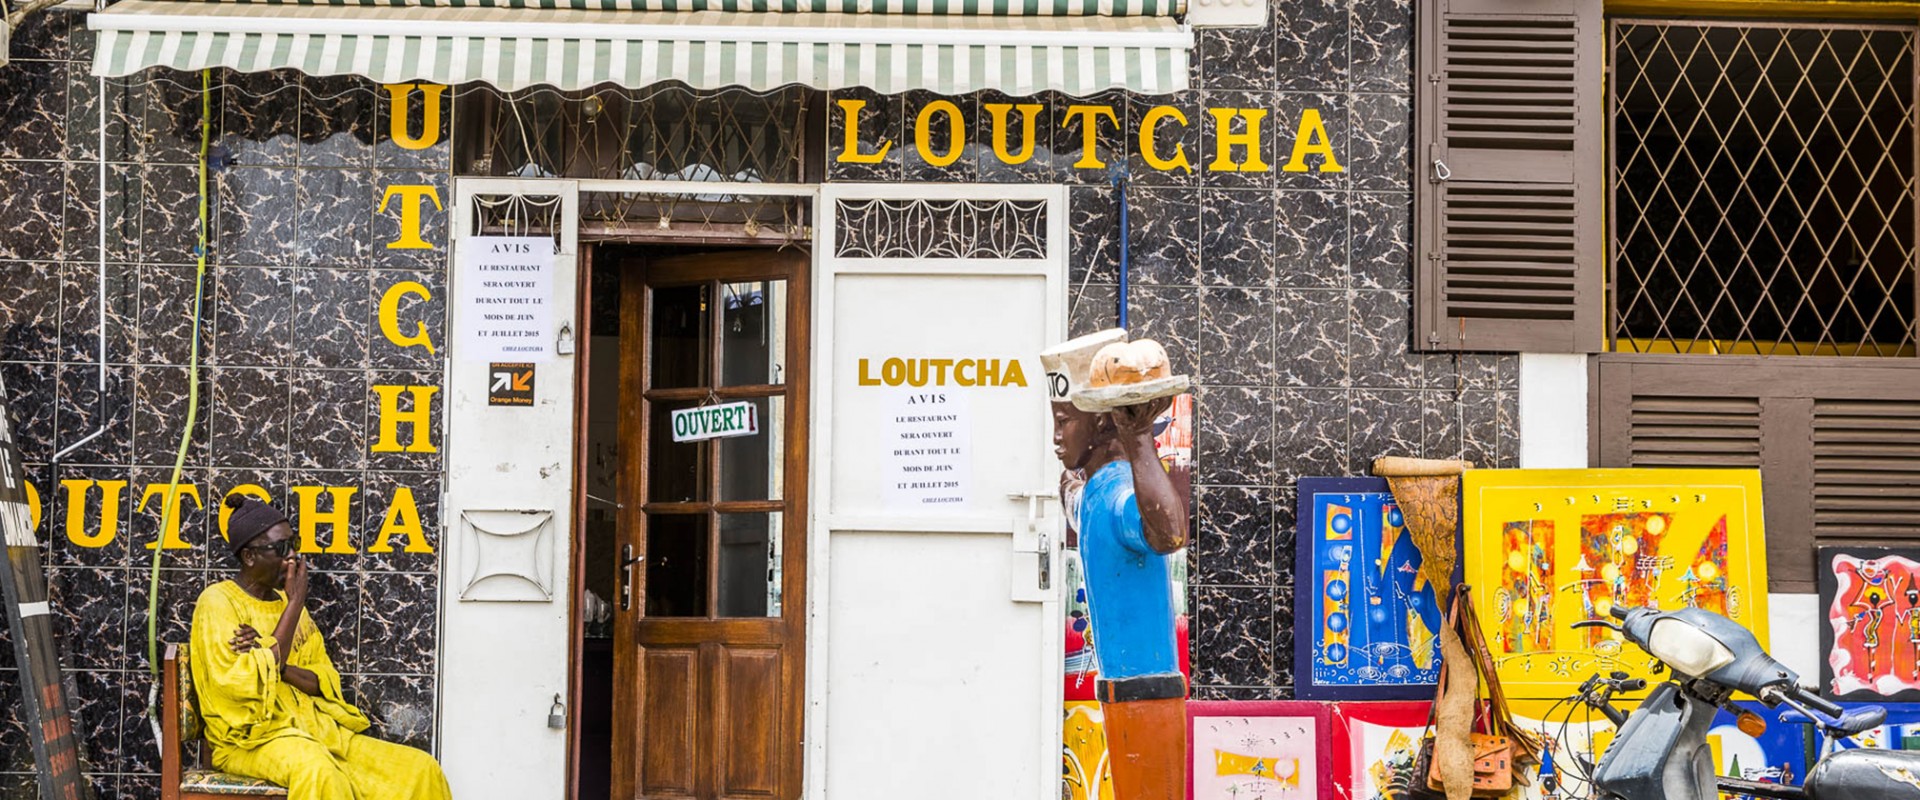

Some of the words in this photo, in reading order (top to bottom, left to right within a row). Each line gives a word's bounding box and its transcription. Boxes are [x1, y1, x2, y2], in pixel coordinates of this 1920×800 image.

[837, 99, 1343, 174] LOUTCHA
[491, 243, 531, 254] AVIS
[479, 264, 489, 272] LE
[490, 264, 541, 272] RESTAURANT
[483, 280, 503, 289] SERA
[504, 280, 536, 289] OUVERT
[475, 297, 507, 305] DURANT
[508, 297, 529, 305] TOUT
[532, 297, 543, 305] LE
[483, 313, 503, 321] MOIS
[505, 313, 515, 321] DE
[517, 313, 535, 321] JUIN
[478, 330, 488, 338] ET
[491, 330, 523, 338] JUILLET
[524, 330, 540, 338] 2015
[858, 357, 1028, 387] LOUTCHA
[490, 396, 511, 404] Orange
[512, 396, 533, 404] Money
[907, 394, 946, 404] AVIS
[675, 405, 746, 437] OUVERT
[907, 415, 958, 423] RESTAURANT
[900, 432, 920, 440] SERA
[893, 448, 925, 456] DURANT
[927, 448, 947, 456] TOUT
[902, 465, 922, 473] MOIS
[935, 464, 953, 472] JUIN
[911, 481, 942, 489] JUILLET
